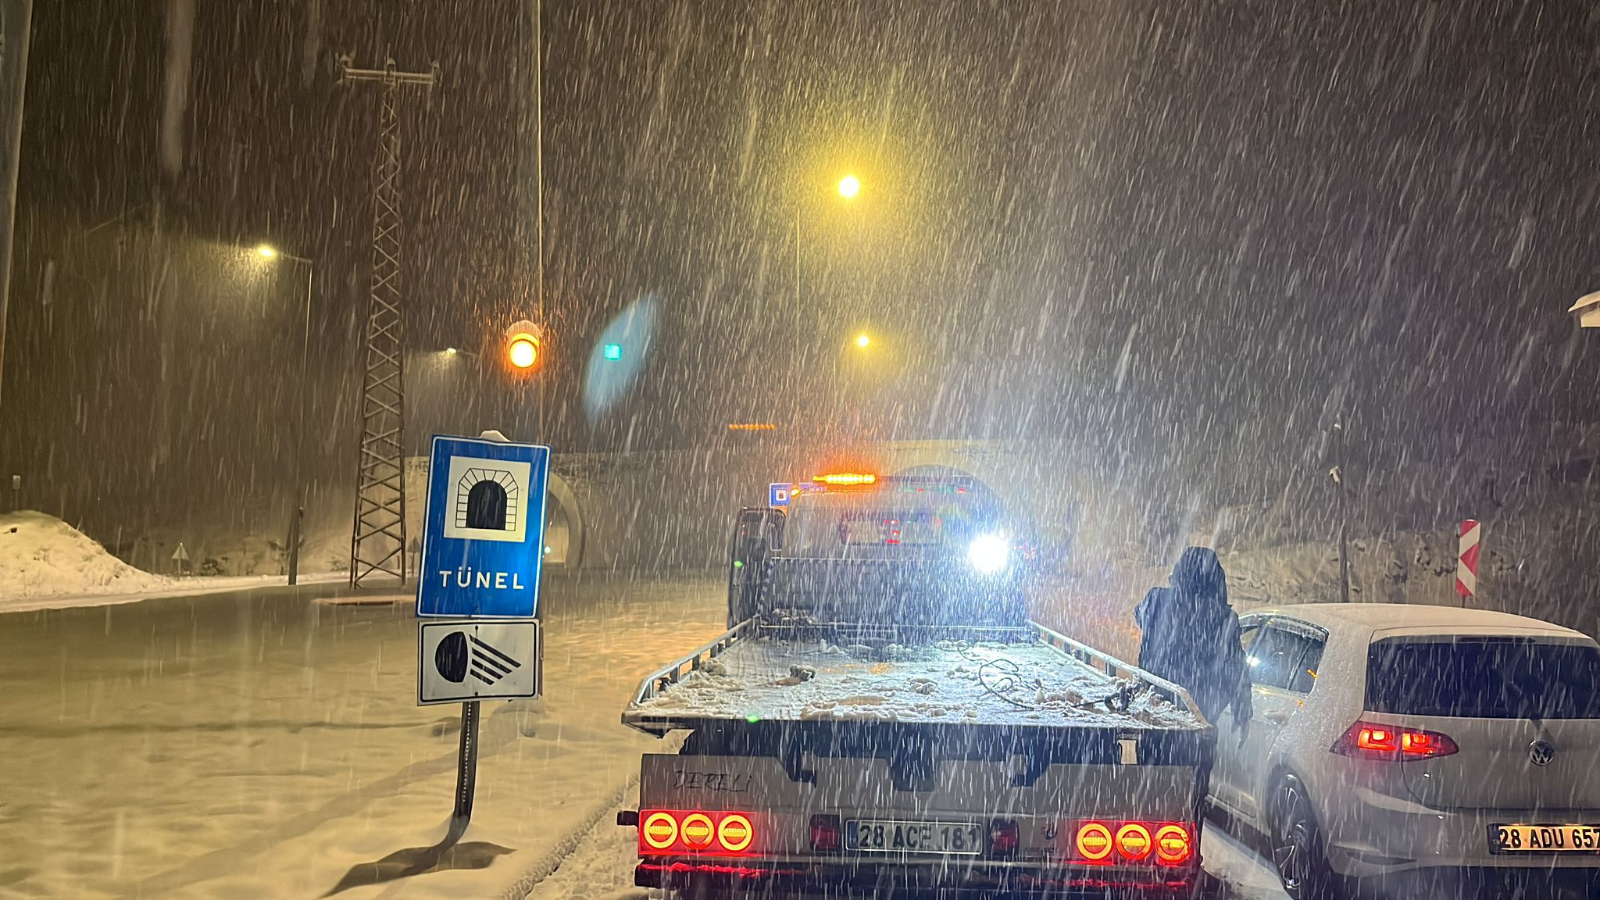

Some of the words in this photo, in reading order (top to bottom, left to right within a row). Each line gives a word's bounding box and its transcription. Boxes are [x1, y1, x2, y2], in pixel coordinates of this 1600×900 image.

[439, 566, 524, 590] TÜNEL
[859, 825, 885, 848] 28
[941, 827, 978, 850] 181
[1499, 828, 1522, 849] 28
[1530, 828, 1565, 849] ADU
[1572, 828, 1600, 849] 657
